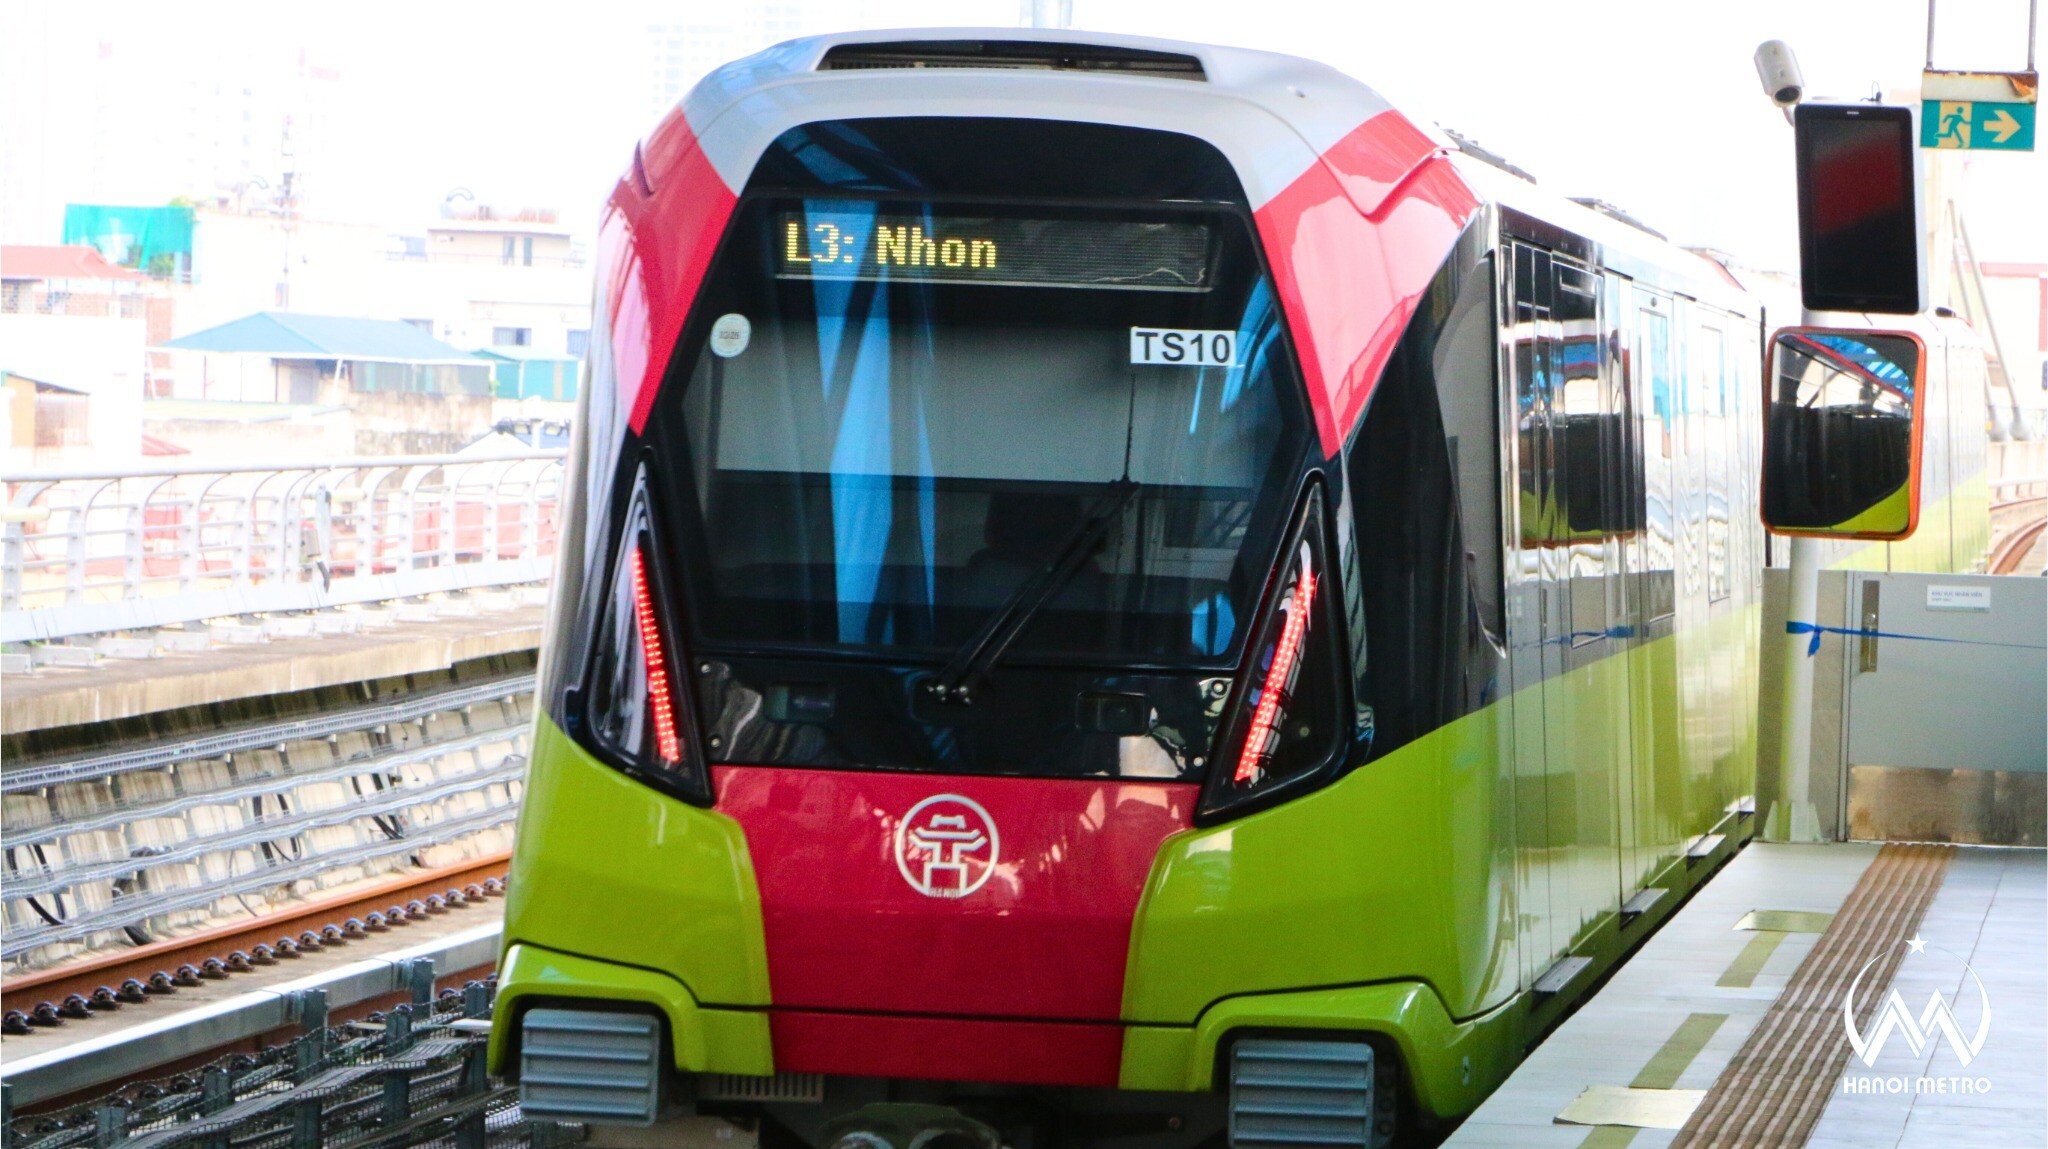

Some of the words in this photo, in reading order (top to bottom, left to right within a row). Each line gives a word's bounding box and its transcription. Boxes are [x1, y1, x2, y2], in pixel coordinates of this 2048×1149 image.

[787, 223, 854, 263] L3:
[876, 226, 996, 268] Nhon
[1135, 331, 1230, 364] TS10
